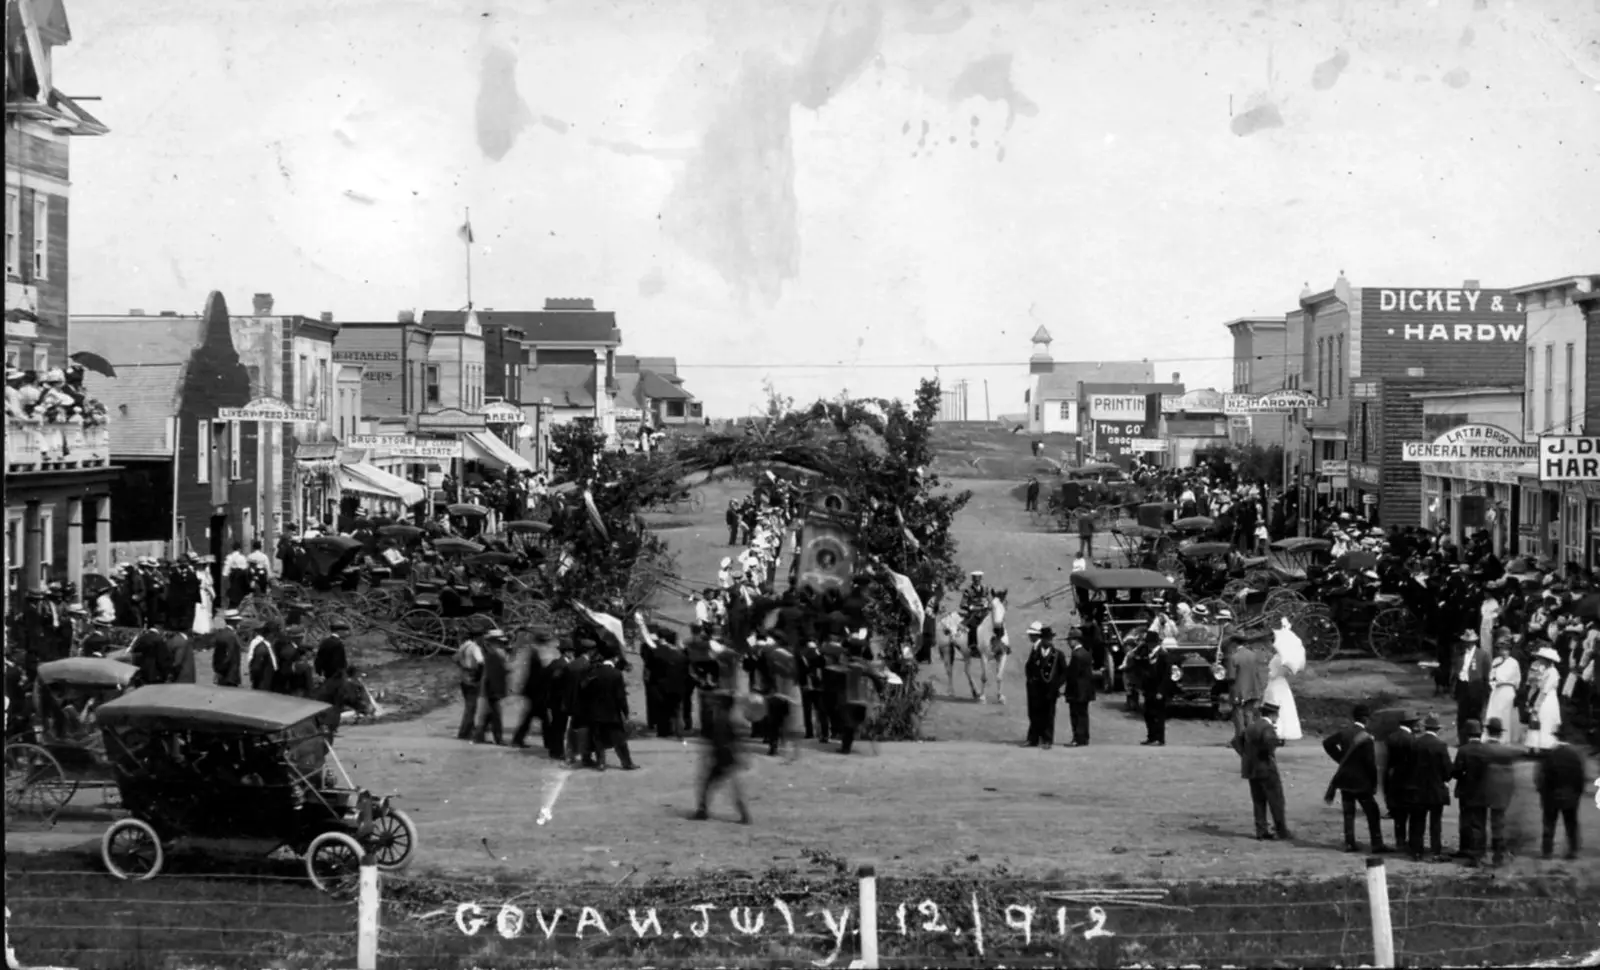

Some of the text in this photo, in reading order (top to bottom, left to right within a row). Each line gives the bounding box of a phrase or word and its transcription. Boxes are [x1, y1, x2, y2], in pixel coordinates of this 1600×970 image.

[1380, 289, 1504, 312] DICKEY &
[1404, 323, 1524, 341] HARDW
[1251, 399, 1325, 407] HARDWARE
[1100, 424, 1145, 435] The GO
[1447, 427, 1482, 444] LATTA
[351, 435, 378, 445] DRUG
[383, 435, 414, 445] STORE
[1547, 438, 1600, 455] J.D
[1408, 444, 1467, 458] GENERAL
[1546, 458, 1599, 477] HAR
